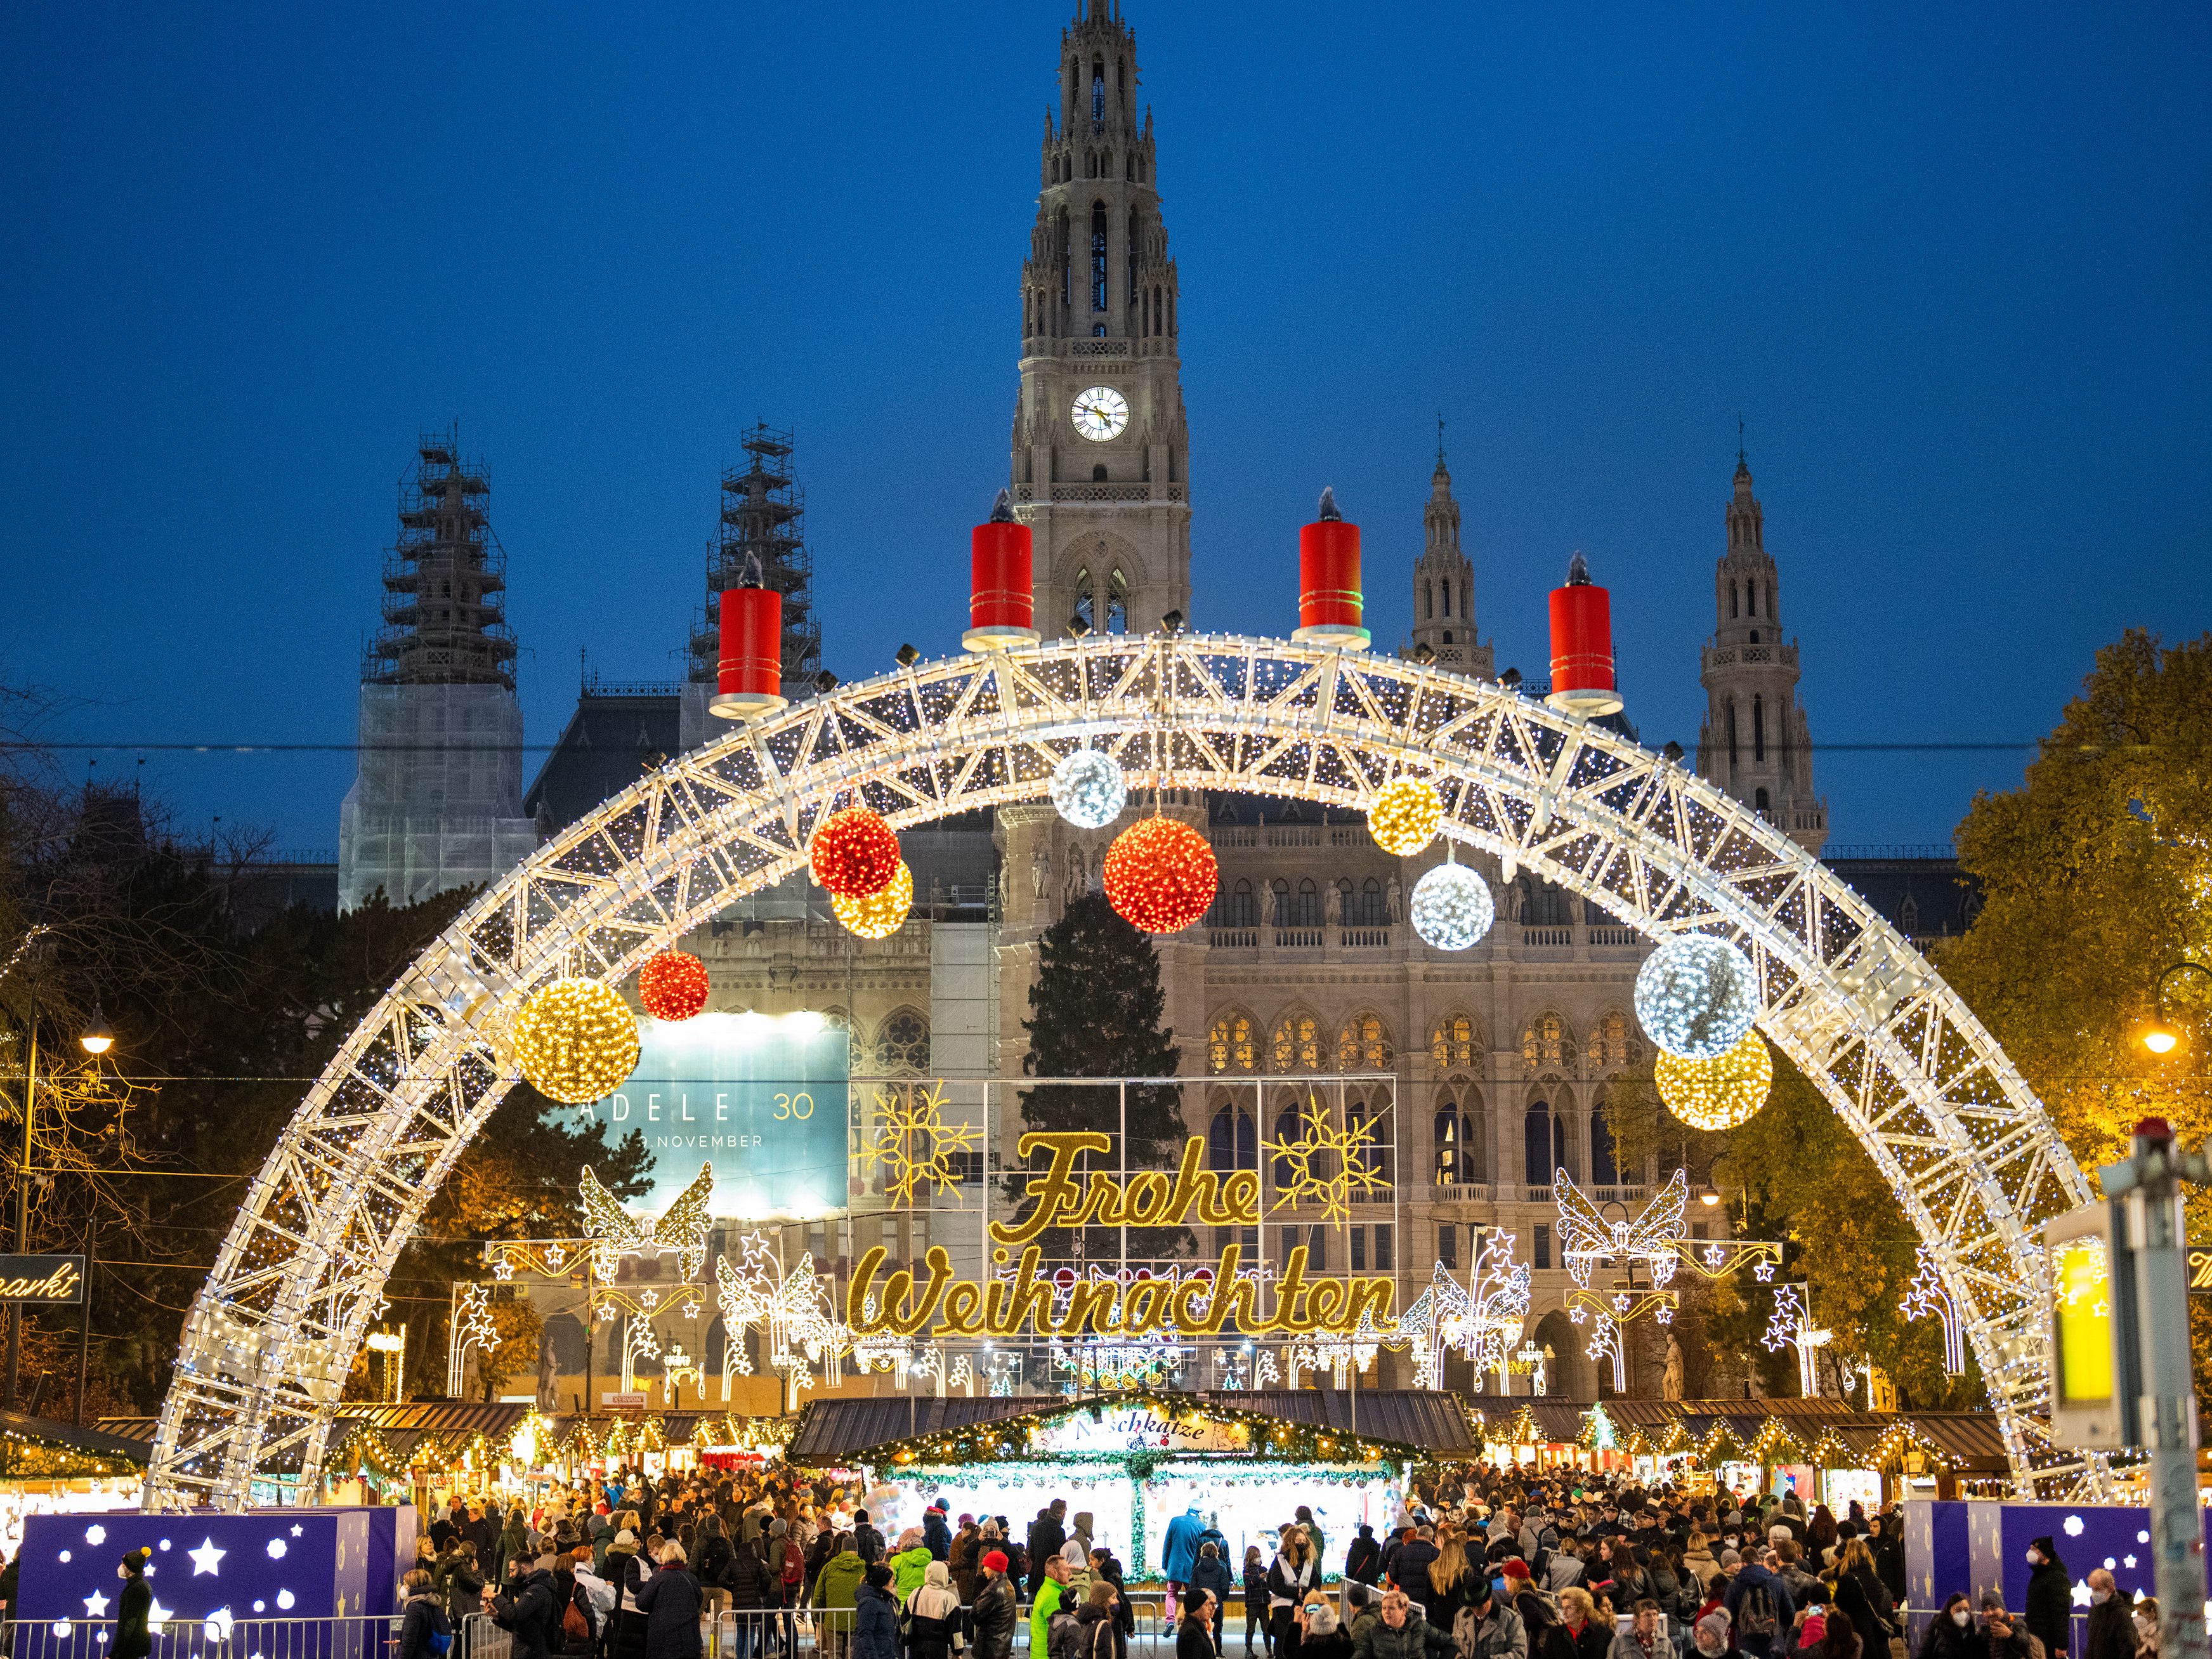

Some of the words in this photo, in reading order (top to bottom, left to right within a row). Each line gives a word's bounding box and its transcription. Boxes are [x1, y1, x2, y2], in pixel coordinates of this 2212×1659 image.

[580, 1093, 728, 1121] ADELE
[773, 1092, 815, 1120] 30
[988, 1131, 1259, 1245] Frohe
[847, 1243, 1400, 1337] Weihnachten
[1076, 1411, 1205, 1441] Nschkatze
